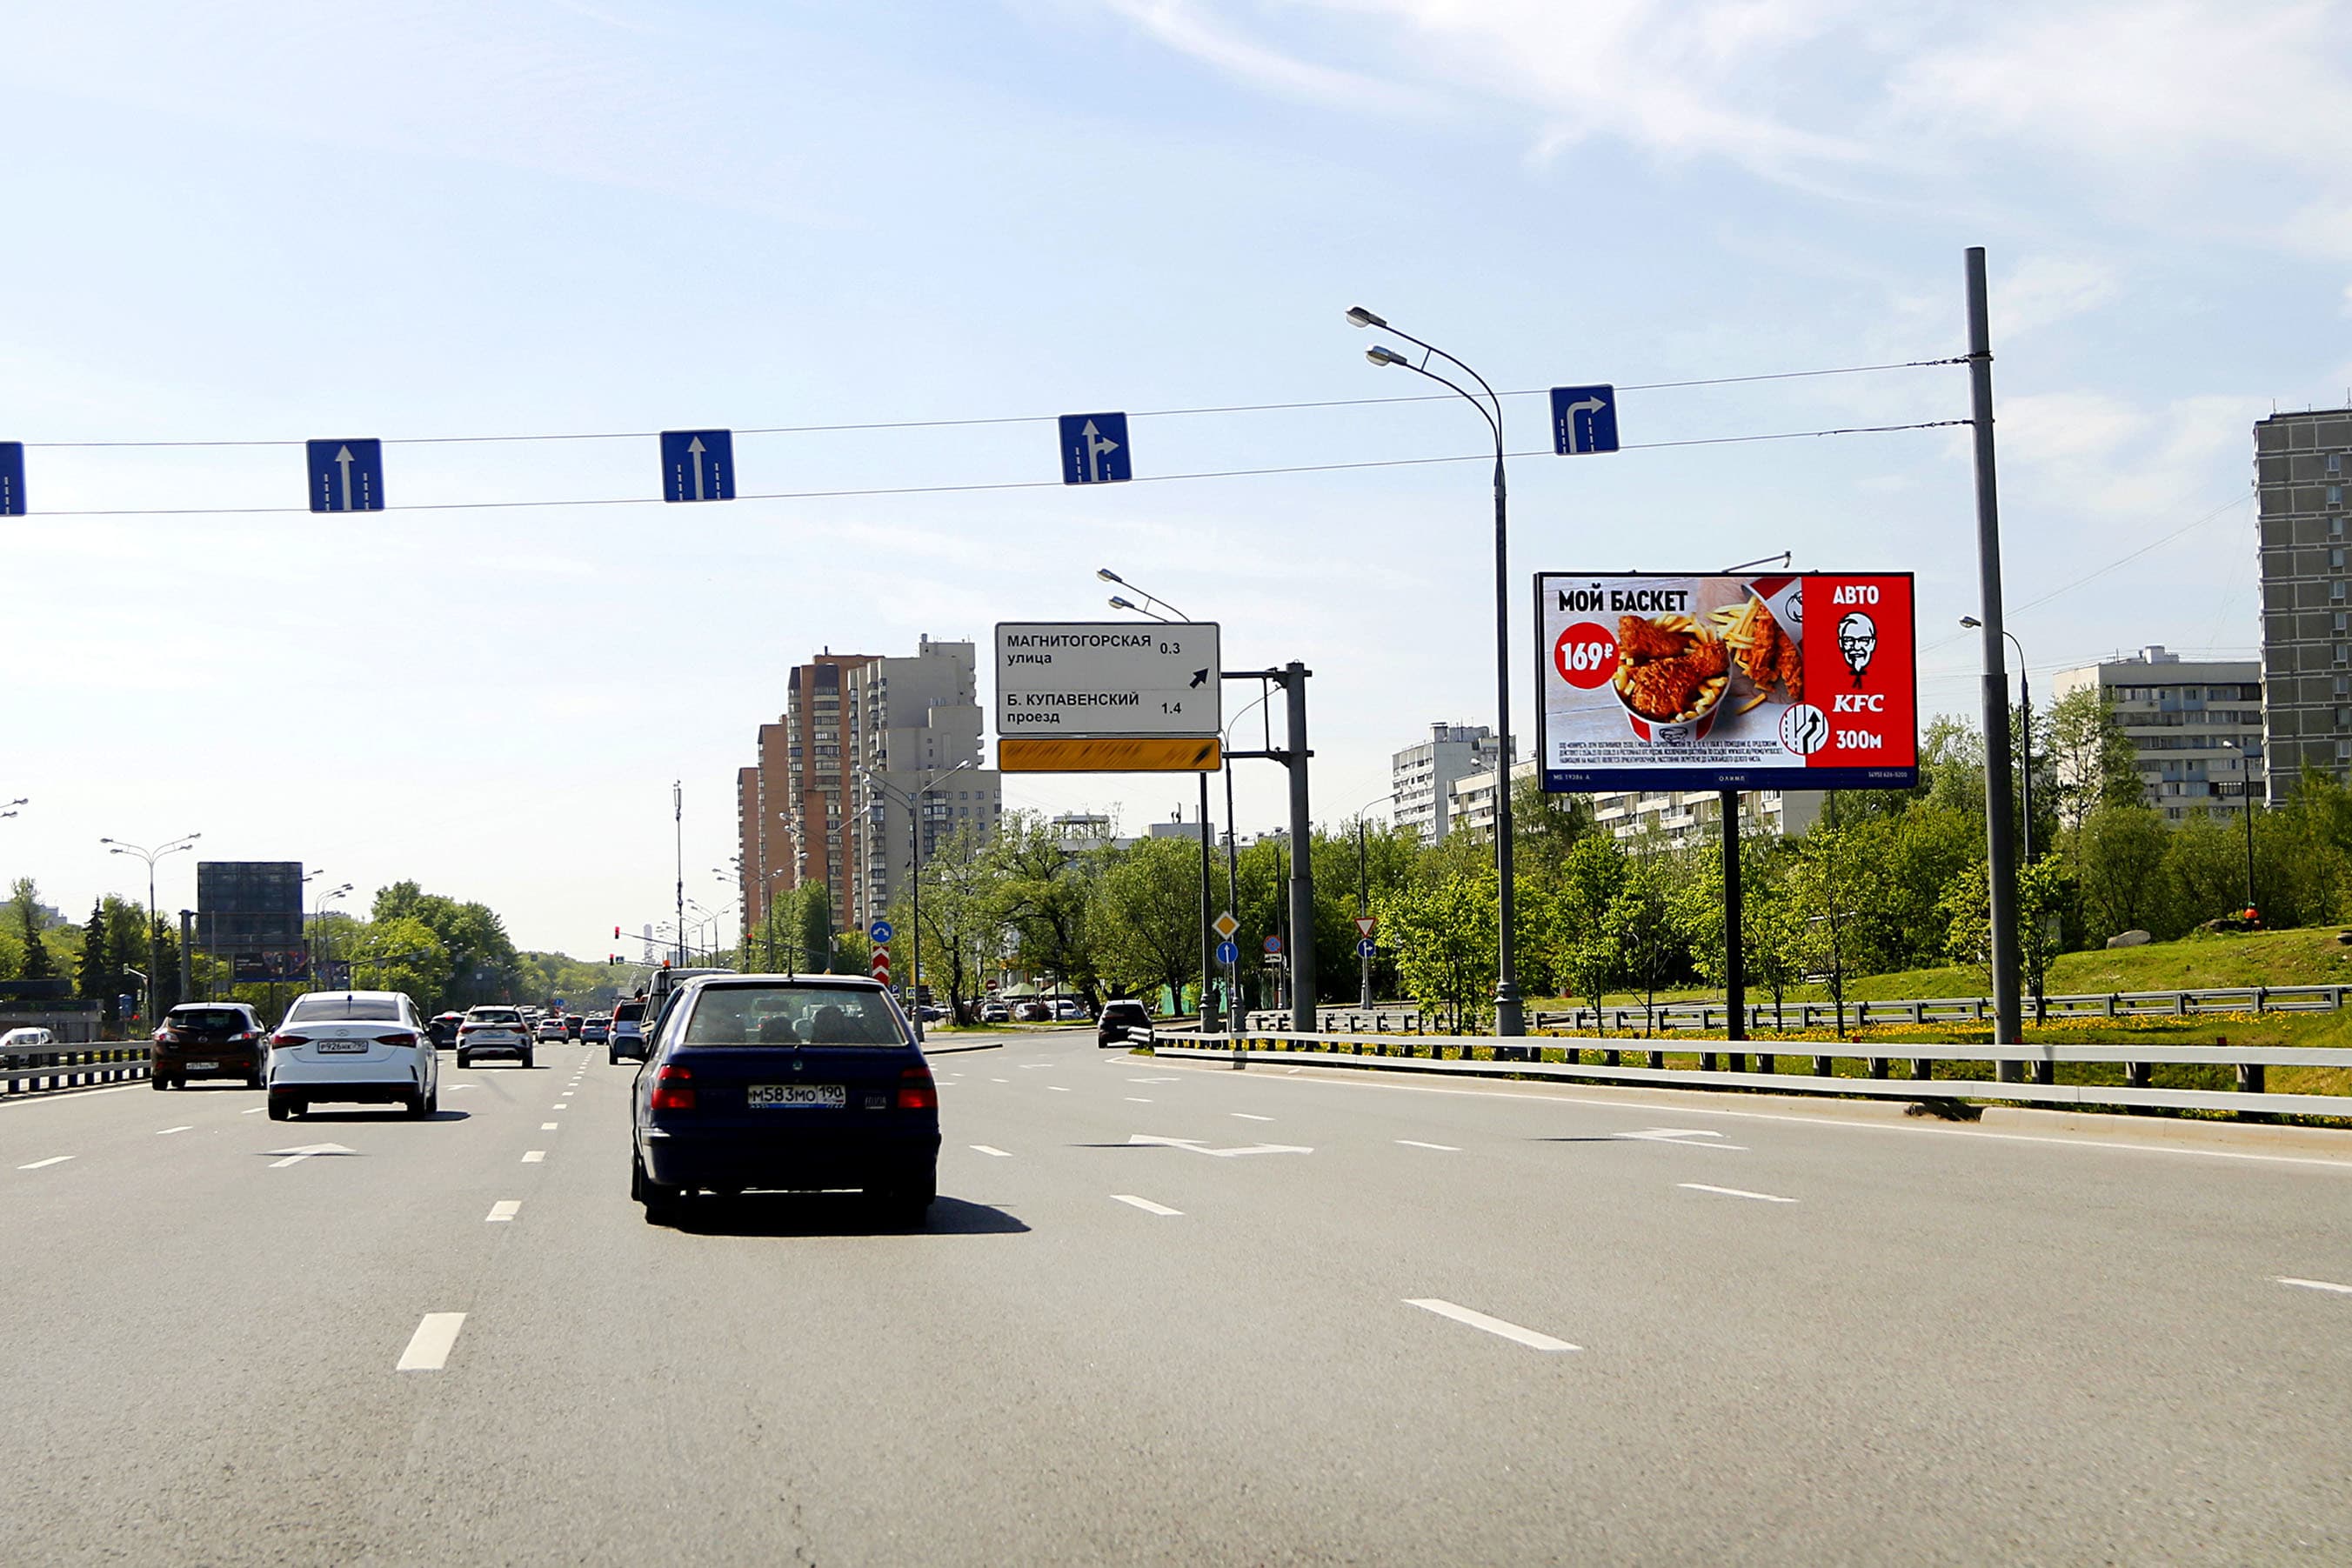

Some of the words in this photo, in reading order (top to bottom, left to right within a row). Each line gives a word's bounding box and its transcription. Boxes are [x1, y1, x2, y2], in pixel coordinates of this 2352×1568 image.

[1559, 583, 1603, 611] МОЙ
[1611, 590, 1688, 611] БАСКЕТ
[1833, 585, 1879, 604] АВТО
[1007, 635, 1152, 647] МАГНИТОГОРСКАЯ
[1159, 642, 1181, 654] 0.3
[1007, 654, 1052, 665] улица
[1007, 694, 1022, 706] Б.
[1026, 691, 1139, 706] КУПАВЕНСКИЙ
[1833, 694, 1885, 713] KFC
[1161, 702, 1182, 714] 1.4
[1007, 713, 1060, 724] проезд
